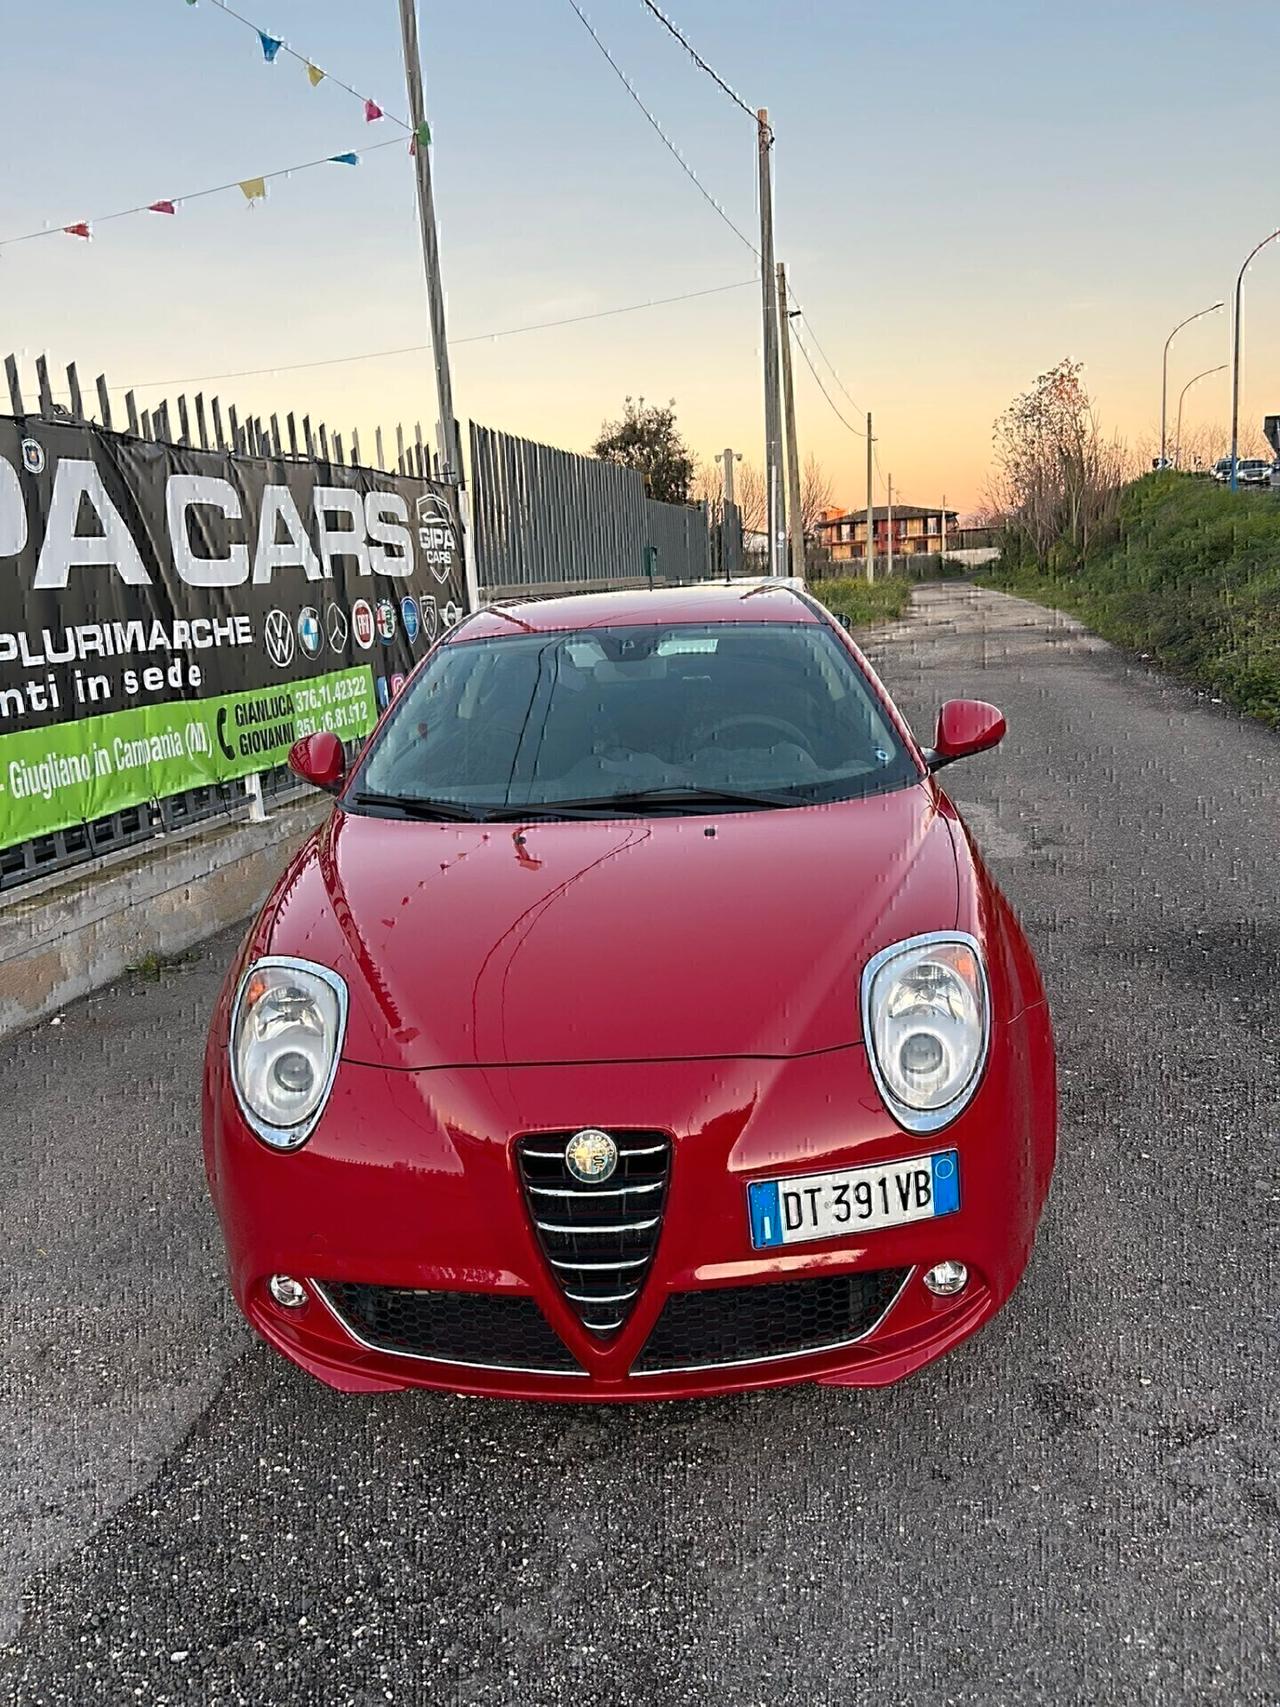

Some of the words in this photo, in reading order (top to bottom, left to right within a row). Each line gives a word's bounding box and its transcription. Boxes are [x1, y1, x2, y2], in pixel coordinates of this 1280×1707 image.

[166, 474, 414, 587] CARS
[419, 527, 455, 550] GIPA
[427, 551, 452, 564] CARS
[0, 616, 253, 667] PLURIMARCHE
[0, 673, 60, 717] nti
[76, 670, 111, 703] in
[124, 658, 202, 695] sede
[235, 694, 295, 727] GIANLUCA
[296, 675, 367, 713] 376.11.42322
[9, 752, 91, 800] Giugliano
[93, 743, 112, 777] in
[113, 726, 184, 771] Campania
[239, 722, 295, 756] GIOVANNI
